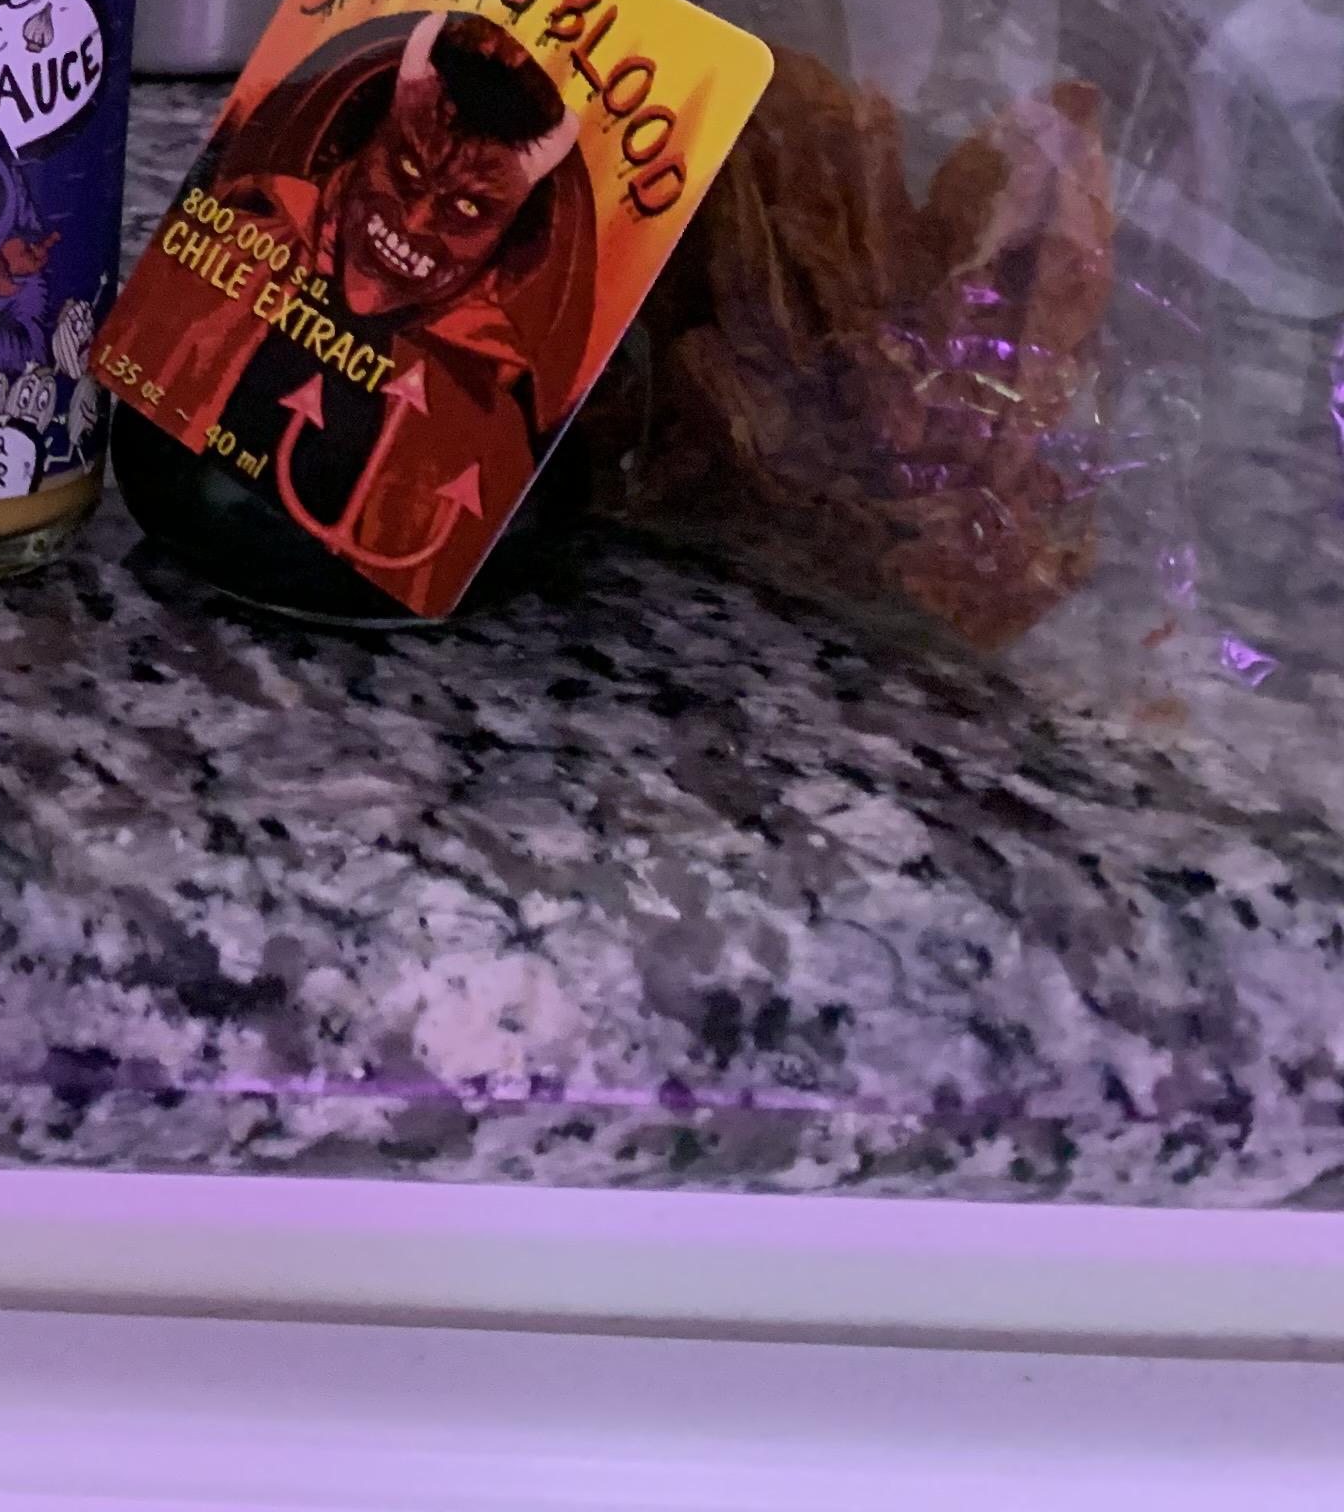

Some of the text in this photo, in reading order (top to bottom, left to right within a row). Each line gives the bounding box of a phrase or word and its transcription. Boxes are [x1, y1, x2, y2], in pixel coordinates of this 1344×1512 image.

[182, 187, 291, 272] 800,000
[162, 220, 396, 393] CHILE EXTRACT
[97, 344, 143, 385] 1.35
[205, 423, 237, 457] 40
[235, 450, 270, 480] ml
